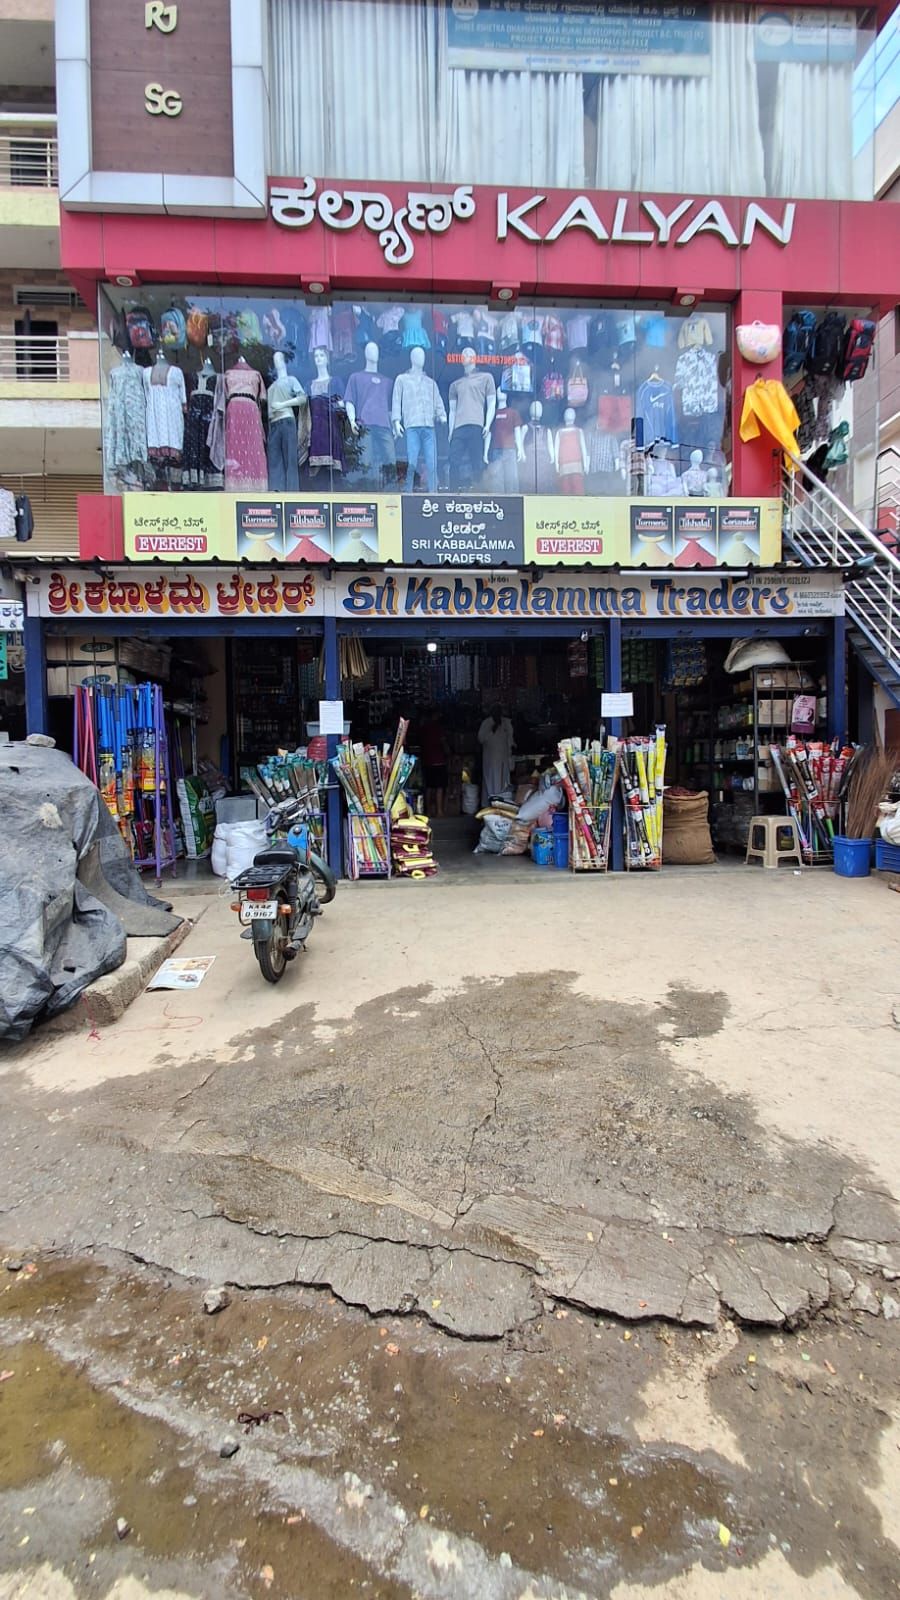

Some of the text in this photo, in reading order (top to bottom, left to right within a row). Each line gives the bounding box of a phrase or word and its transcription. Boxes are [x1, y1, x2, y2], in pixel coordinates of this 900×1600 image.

[144, 82, 182, 116] SG
[270, 175, 476, 265] ಕಲ್ಯಾಣ್
[497, 192, 796, 249] KALYAN
[422, 499, 439, 517] ಶ್ರೀ
[138, 536, 204, 551] EVEREST
[411, 539, 516, 550] SRI KABBALAMMA
[541, 539, 600, 553] EVEREST
[437, 553, 492, 563] TRADERS
[342, 576, 795, 615] Sri Kabbalamma Traders
